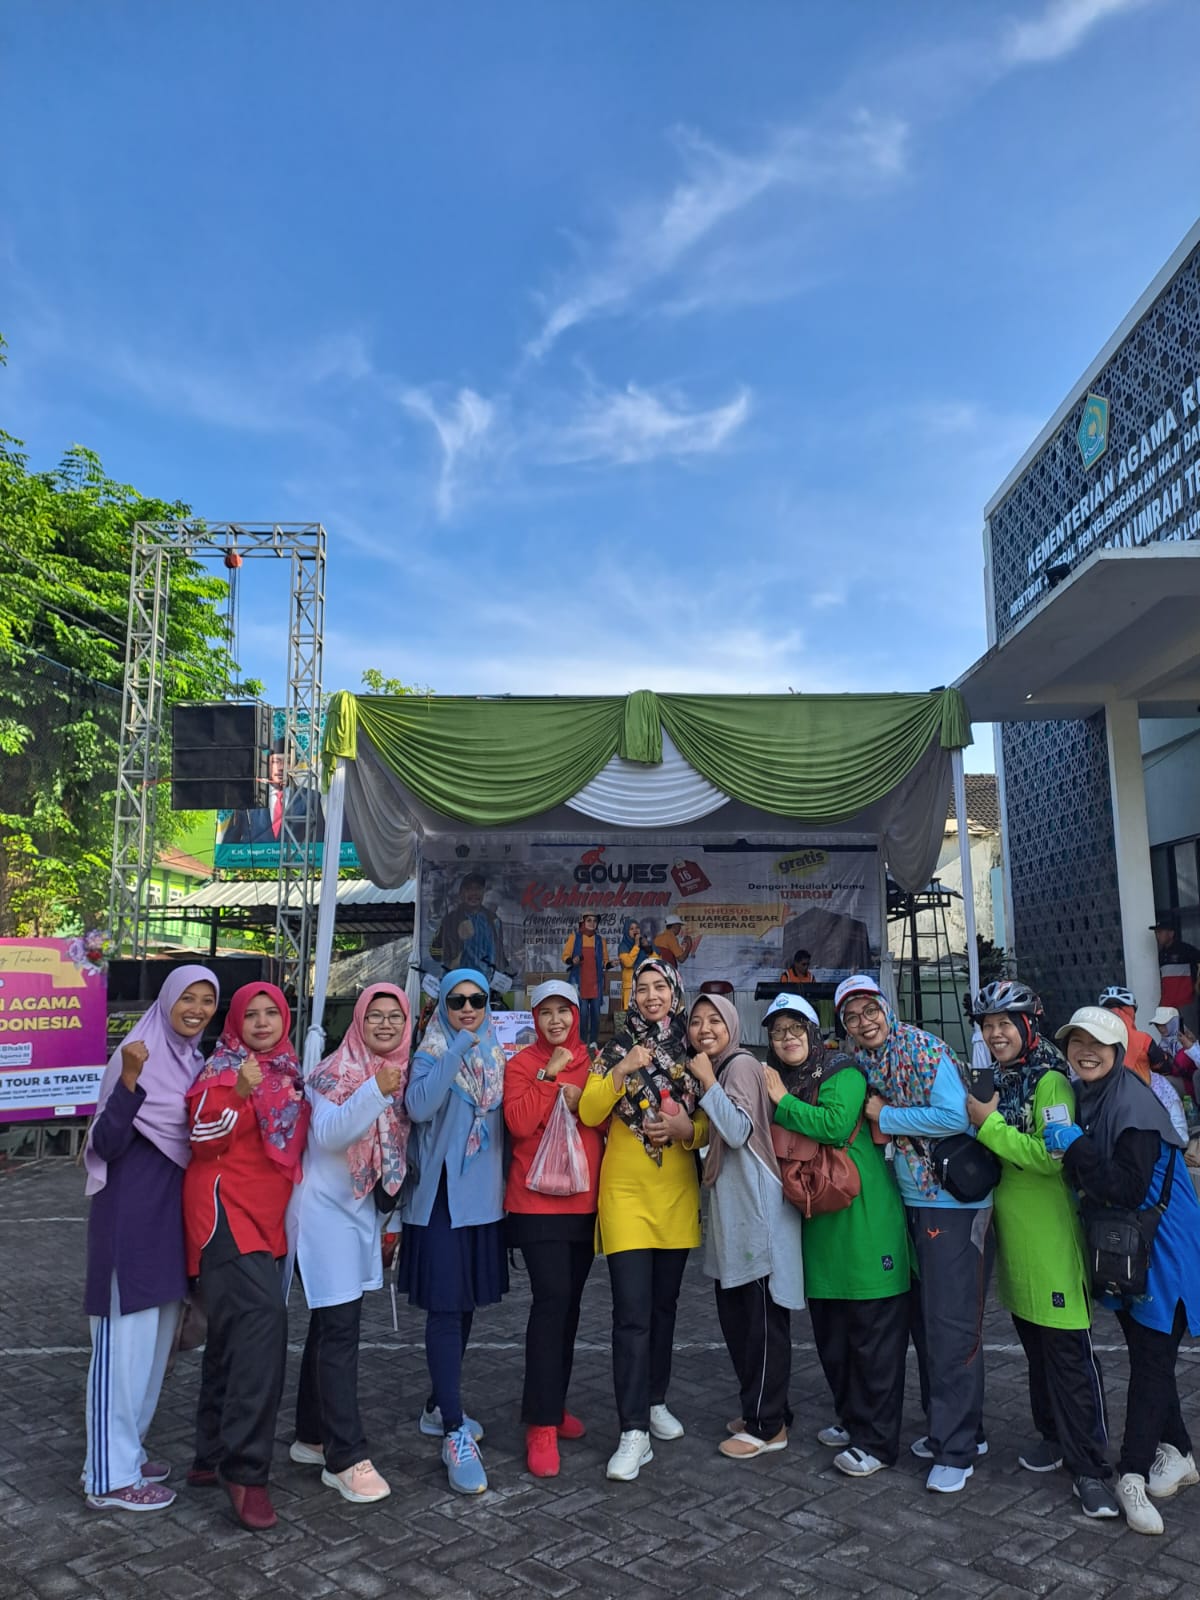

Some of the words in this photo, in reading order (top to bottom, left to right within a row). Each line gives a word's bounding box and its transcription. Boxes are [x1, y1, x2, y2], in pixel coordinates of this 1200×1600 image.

[1027, 468, 1115, 577] KEMENTERIAN
[1118, 407, 1178, 486] AGAMA
[1077, 465, 1156, 553] PENYELENGGARAAN
[1158, 442, 1180, 478] HAJI
[1133, 477, 1182, 545] UMRAH
[778, 851, 825, 874] gratis
[573, 863, 670, 884] GOWES
[678, 870, 693, 883] 16
[748, 883, 788, 891] Dengan
[780, 890, 833, 900] UMROH
[521, 881, 673, 912] Kebhinekaan
[10, 950, 52, 966] Tahun
[9, 996, 82, 1012] AGAMA
[5, 1077, 41, 1088] TOUR
[43, 1076, 51, 1085] &
[53, 1073, 101, 1084] TRAVEL
